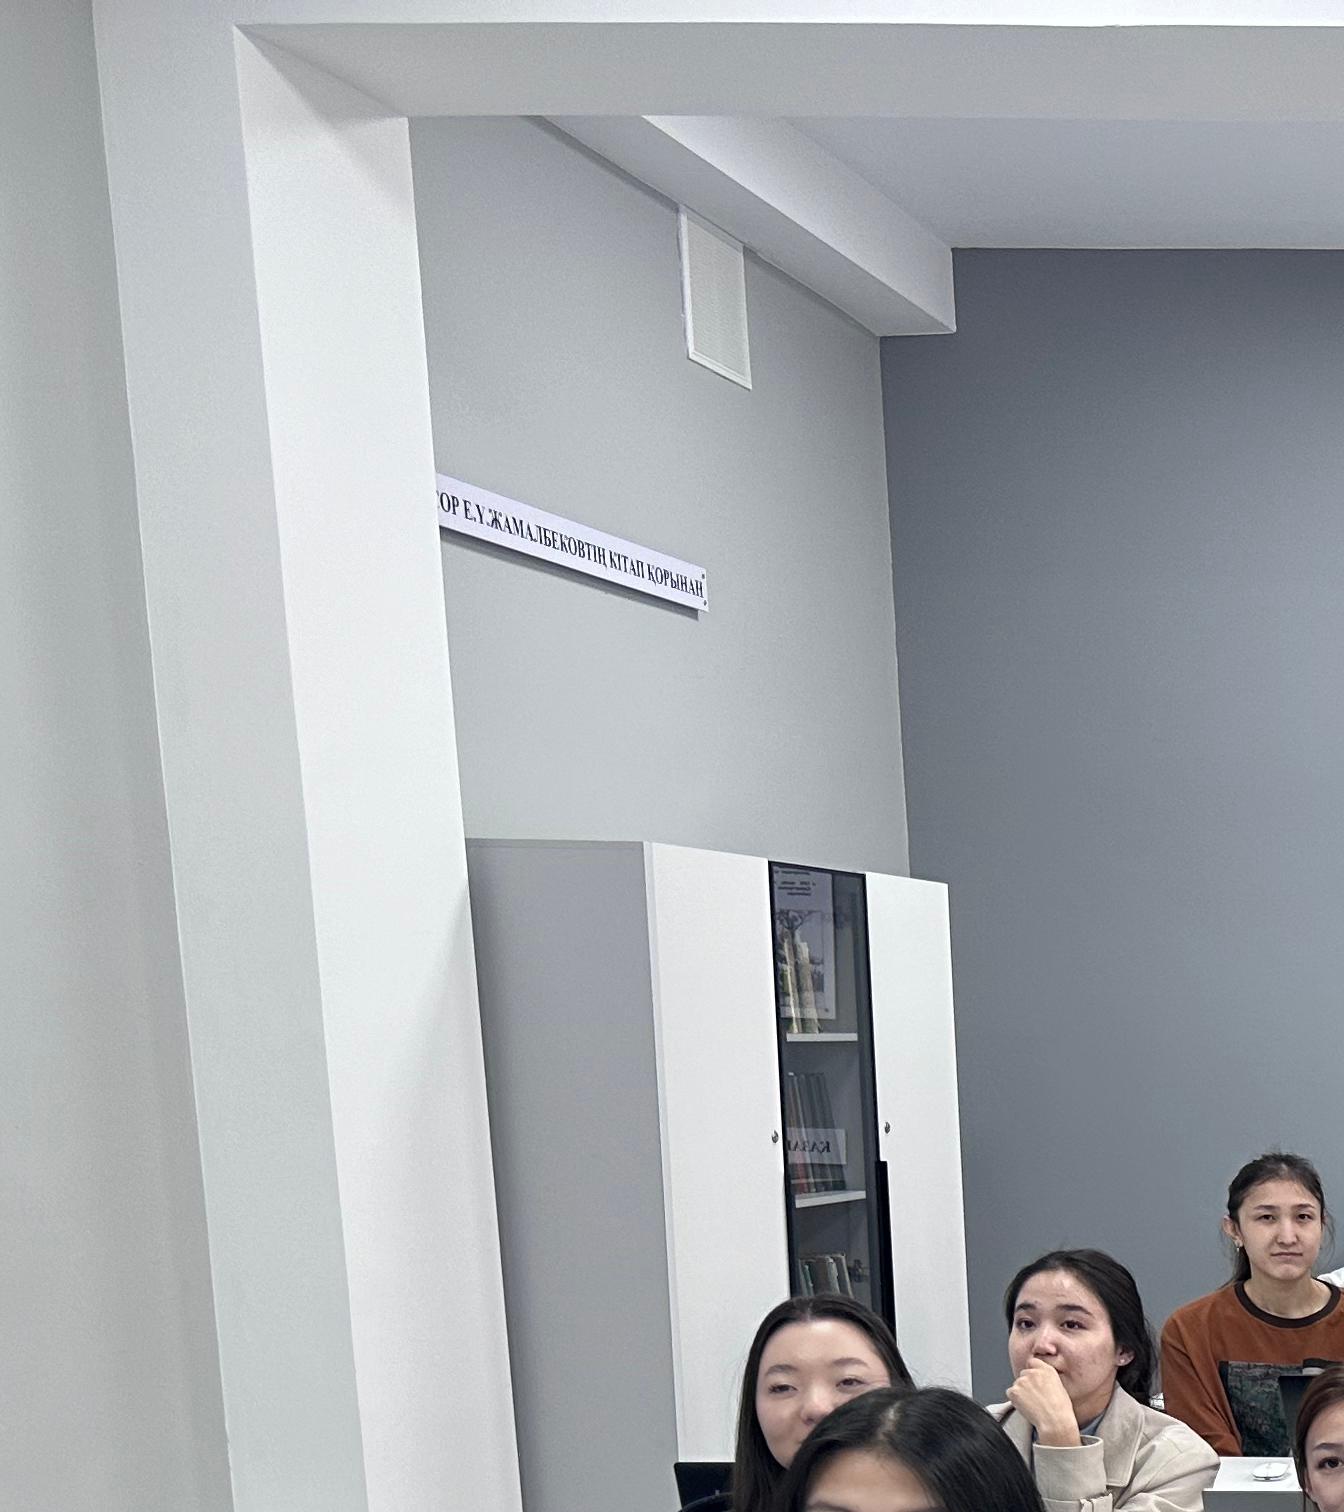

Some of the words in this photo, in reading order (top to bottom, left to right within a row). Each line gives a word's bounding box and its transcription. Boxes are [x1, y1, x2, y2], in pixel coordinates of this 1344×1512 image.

[436, 490, 459, 515] ОР
[609, 551, 646, 579] КІТАП
[647, 564, 704, 599] ҚОРЫНАН
